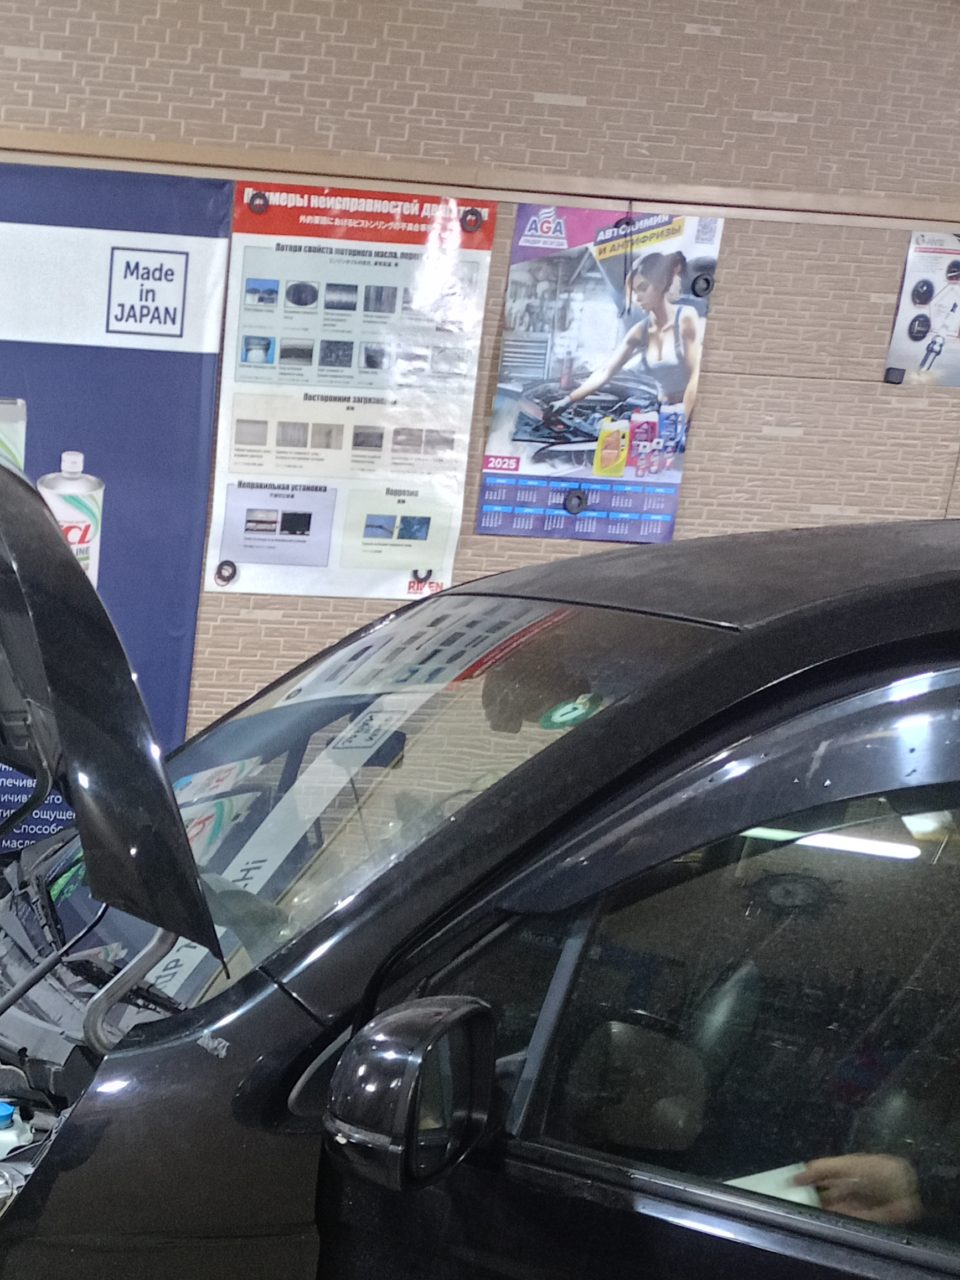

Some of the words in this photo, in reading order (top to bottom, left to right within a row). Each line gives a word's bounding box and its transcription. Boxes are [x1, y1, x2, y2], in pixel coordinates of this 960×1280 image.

[524, 217, 566, 236] AGA
[123, 260, 175, 283] Made
[139, 284, 156, 303] in
[114, 303, 177, 326] JAPAN
[488, 457, 517, 469] 2025
[60, 523, 92, 545] CL
